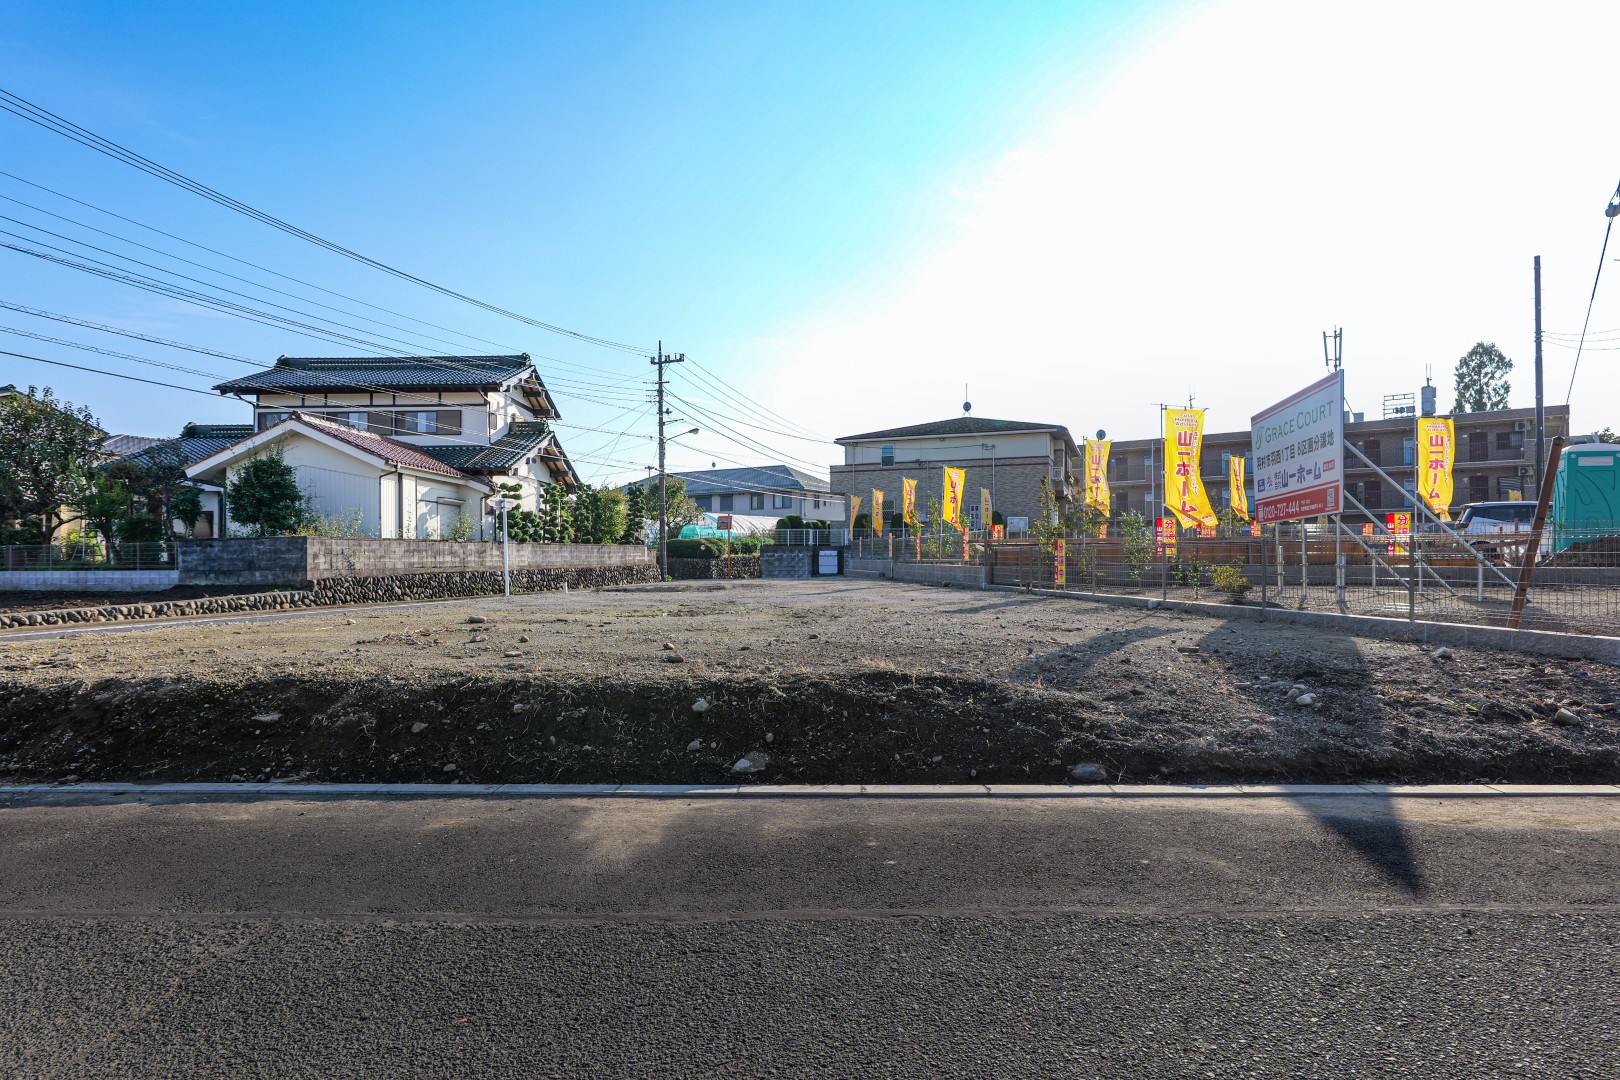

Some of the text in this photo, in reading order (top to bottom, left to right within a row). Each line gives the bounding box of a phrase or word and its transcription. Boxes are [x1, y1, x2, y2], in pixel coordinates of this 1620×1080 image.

[1265, 400, 1333, 443] GRACE COURT
[1177, 430, 1198, 513] 山一ホーム
[1282, 461, 1322, 488] 山一ホーム
[1429, 434, 1444, 499] 山一ホーム
